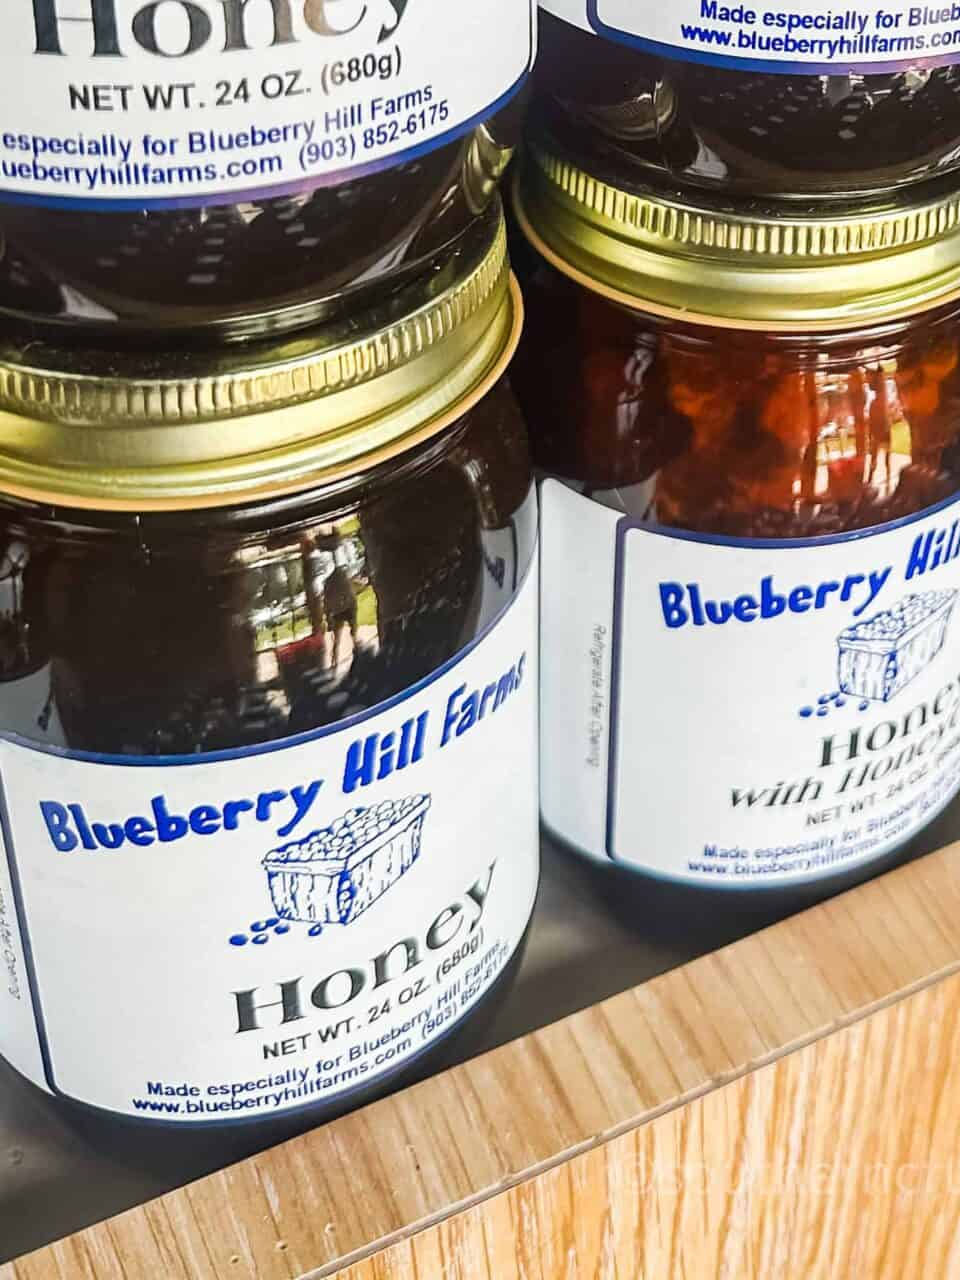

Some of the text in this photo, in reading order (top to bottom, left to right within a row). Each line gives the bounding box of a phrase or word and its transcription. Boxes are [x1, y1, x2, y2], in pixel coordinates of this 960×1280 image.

[762, 10, 869, 34] especially
[875, 10, 903, 30] for
[68, 45, 402, 111] NET WT. 24 OZ. (680g)
[2, 85, 433, 162] especially for Blueberry Hill Farms
[2, 99, 449, 190] ueberryhillfarms.com (903) 852-6175
[658, 566, 893, 628] Blueberry
[40, 651, 527, 854] Blueberry Hill Farms
[730, 776, 823, 808] with
[806, 804, 843, 827] NET
[703, 843, 749, 859] Made
[230, 857, 497, 1034] Honey
[262, 1032, 312, 1060] NET
[318, 1016, 361, 1044] WT.
[368, 998, 393, 1024] 24
[436, 926, 484, 982] (680g)
[132, 1038, 413, 1114] www.blueberryhillfarms.com
[421, 1005, 457, 1039] (903)
[147, 1081, 201, 1097] Made
[207, 1067, 310, 1097] especially
[316, 1053, 343, 1074] for
[349, 1004, 433, 1062] Blueberry
[437, 981, 461, 1009] Hill
